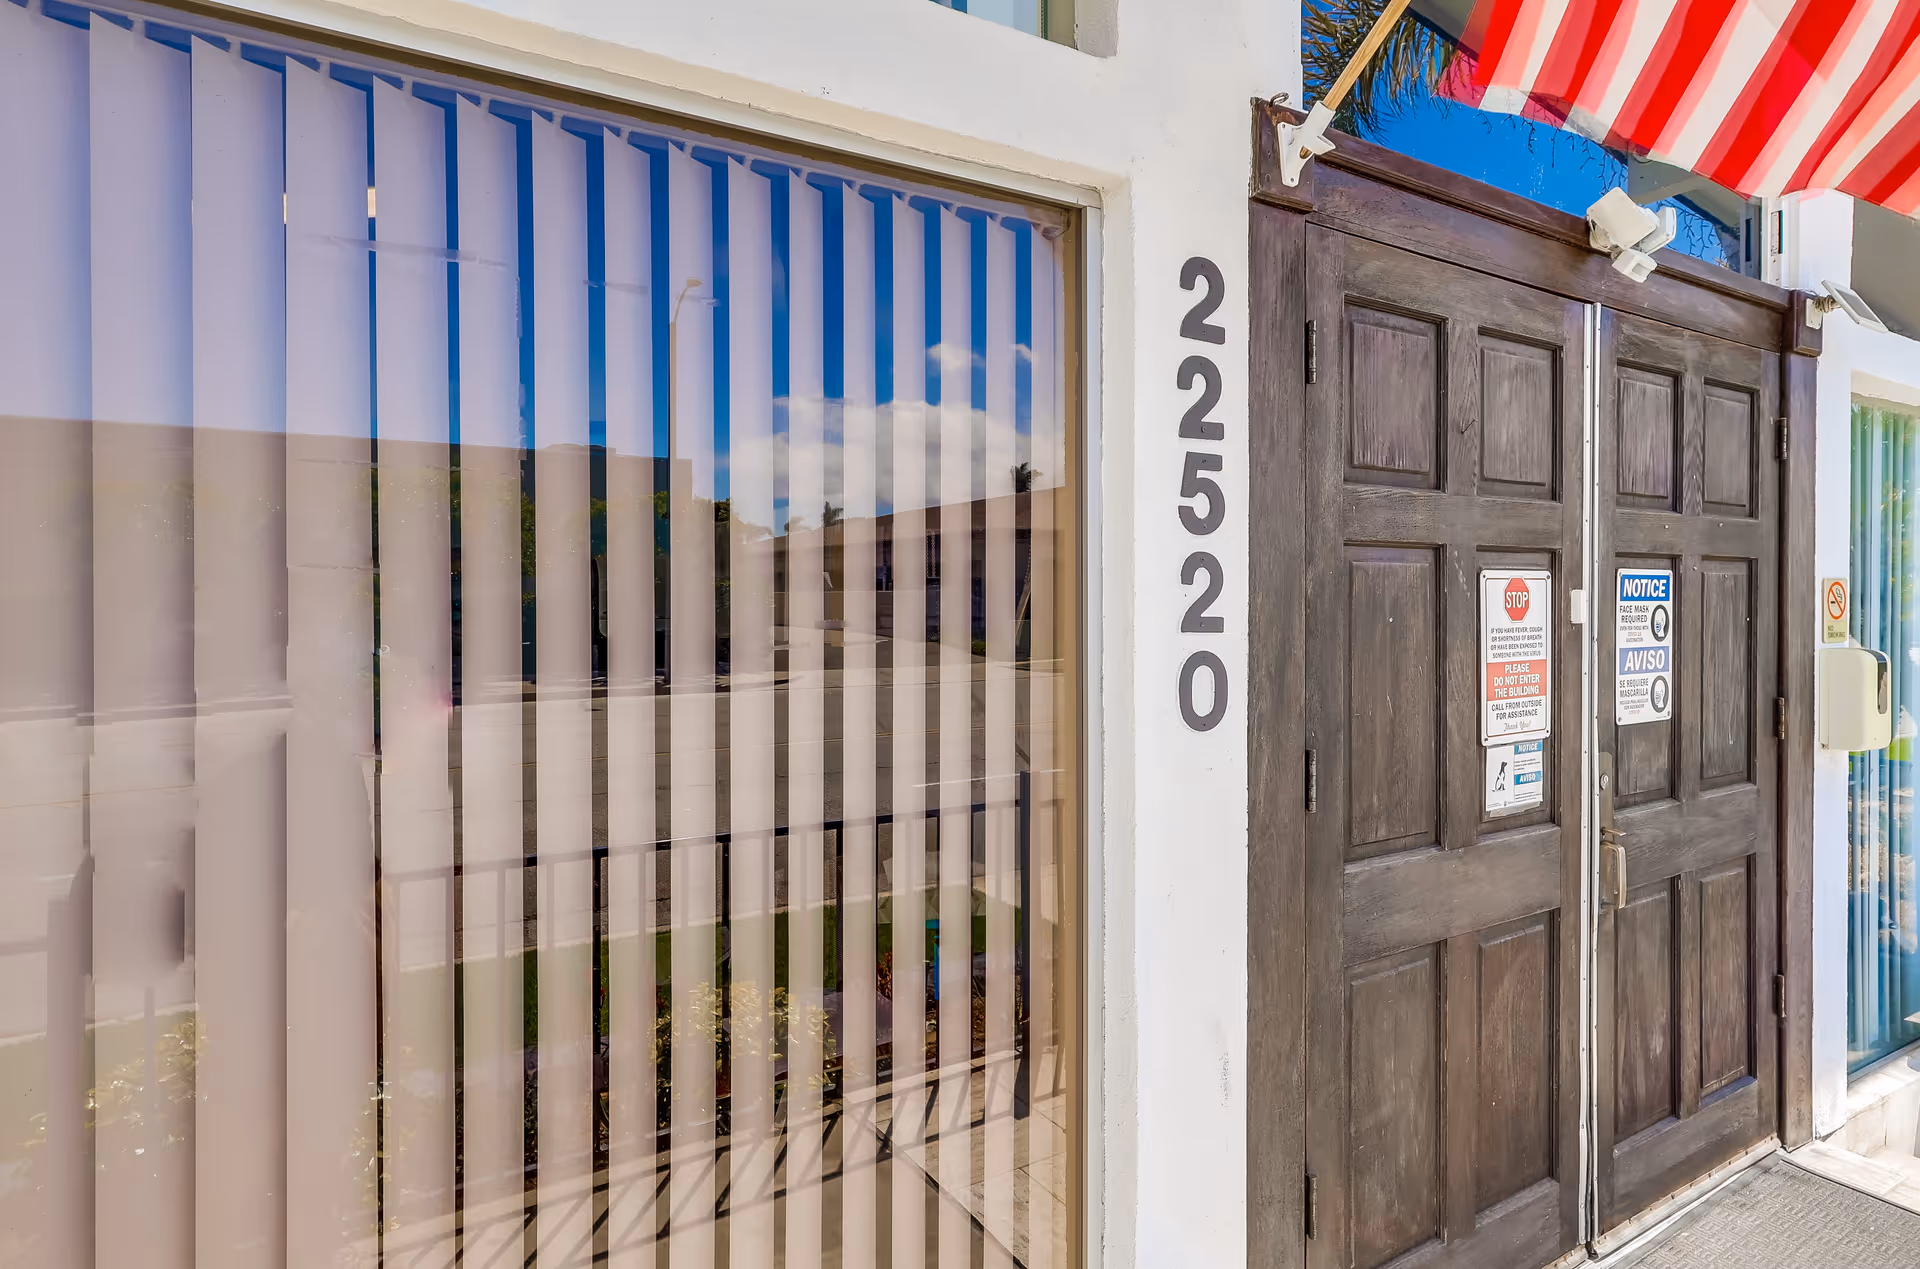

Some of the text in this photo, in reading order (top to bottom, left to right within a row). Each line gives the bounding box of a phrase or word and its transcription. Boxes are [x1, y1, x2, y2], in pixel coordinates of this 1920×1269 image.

[1177, 256, 1228, 732] 22520
[1623, 578, 1667, 597] NOTICE
[1506, 592, 1528, 608] STOP
[1619, 604, 1649, 613] FACE MASK
[1621, 614, 1648, 624] REQUIRED
[1492, 651, 1511, 659] SOMEONE
[1624, 649, 1665, 671] AVISO
[1505, 663, 1529, 673] PLEASE
[1494, 674, 1540, 686] DO NOT ENTER
[1619, 678, 1648, 688] SE REQUIERE
[1494, 685, 1539, 698] THE BUILDING
[1619, 688, 1648, 698] MASCARILLA
[1505, 701, 1520, 710] FROM
[1521, 699, 1542, 708] OUTSIDE
[1496, 709, 1538, 720] FOR ASSISTANCE
[1504, 722, 1518, 732] Thank
[1518, 743, 1538, 752] NOTICE
[1519, 773, 1536, 783] AVISO
